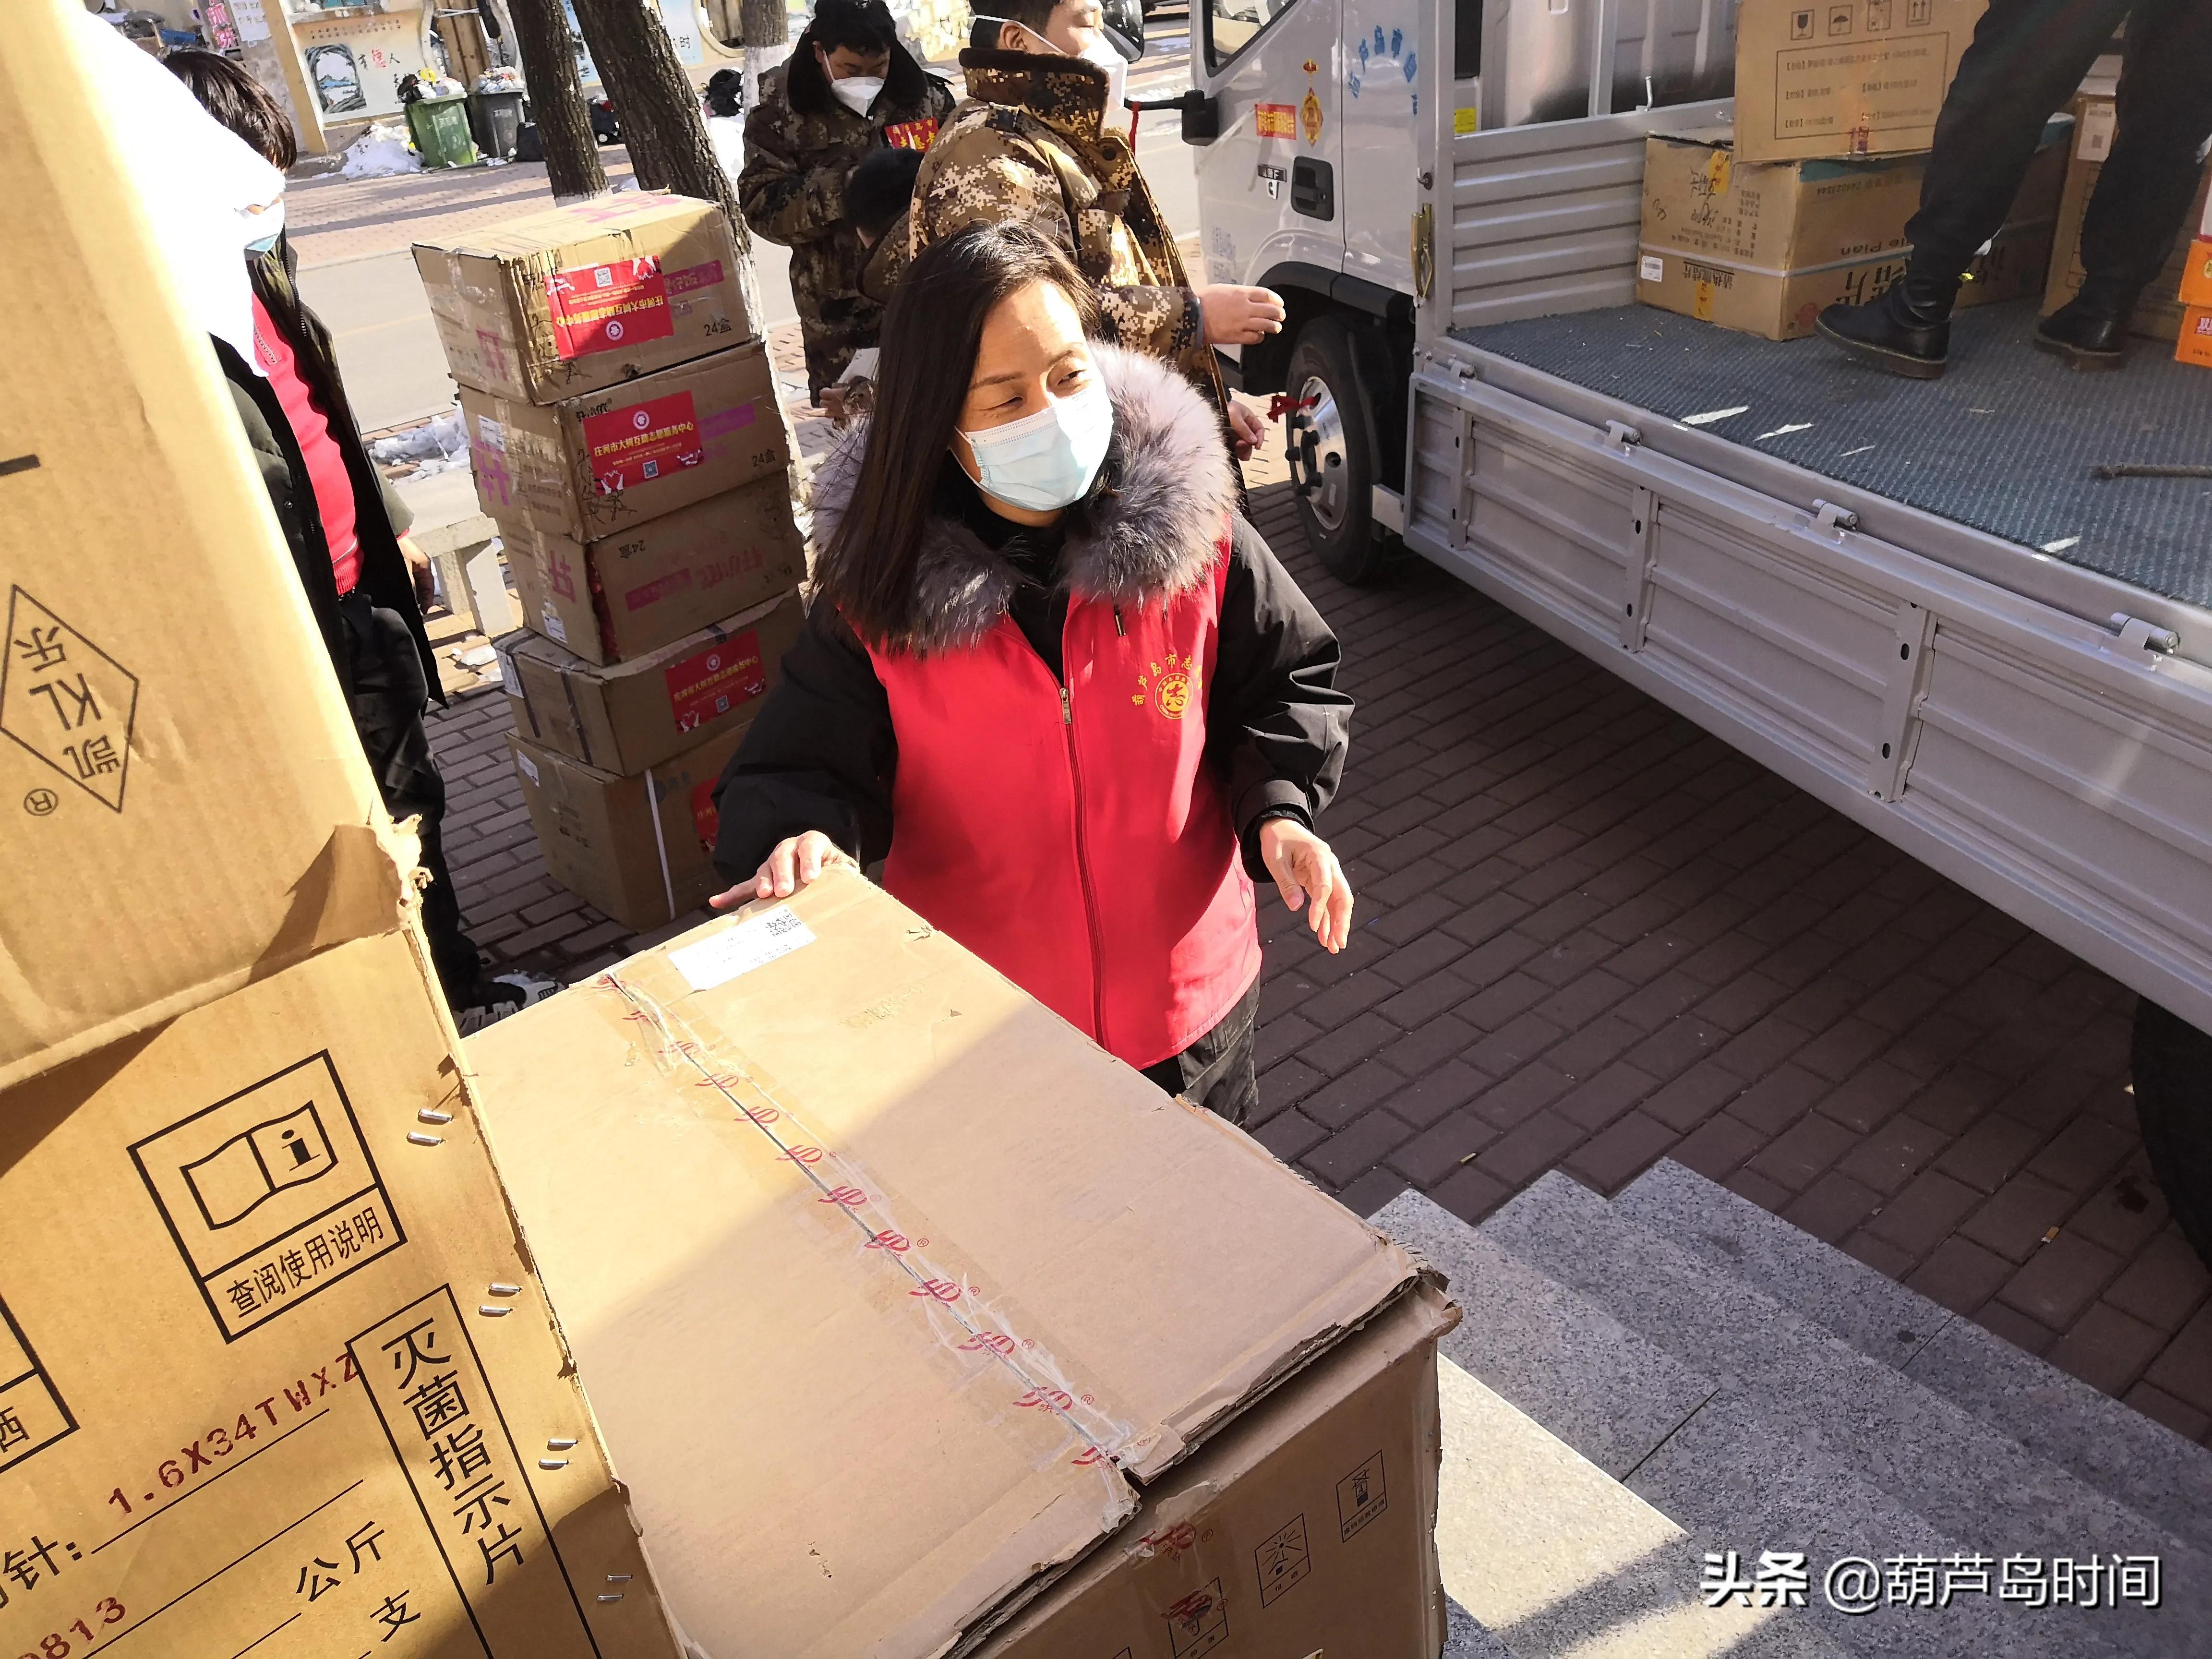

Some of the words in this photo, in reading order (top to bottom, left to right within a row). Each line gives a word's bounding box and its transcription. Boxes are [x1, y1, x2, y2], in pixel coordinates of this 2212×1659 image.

[704, 319, 732, 336] 24盒
[13, 626, 66, 673] 乐
[30, 673, 101, 731] KL
[63, 735, 120, 780] 凯
[227, 1207, 384, 1318] 查阅使用说明
[382, 1318, 524, 1585] 灭菌指示片
[0, 1536, 83, 1609] 针:
[297, 1521, 386, 1602] 公斤
[18, 1597, 126, 1659] 813
[371, 1589, 421, 1642] 支
